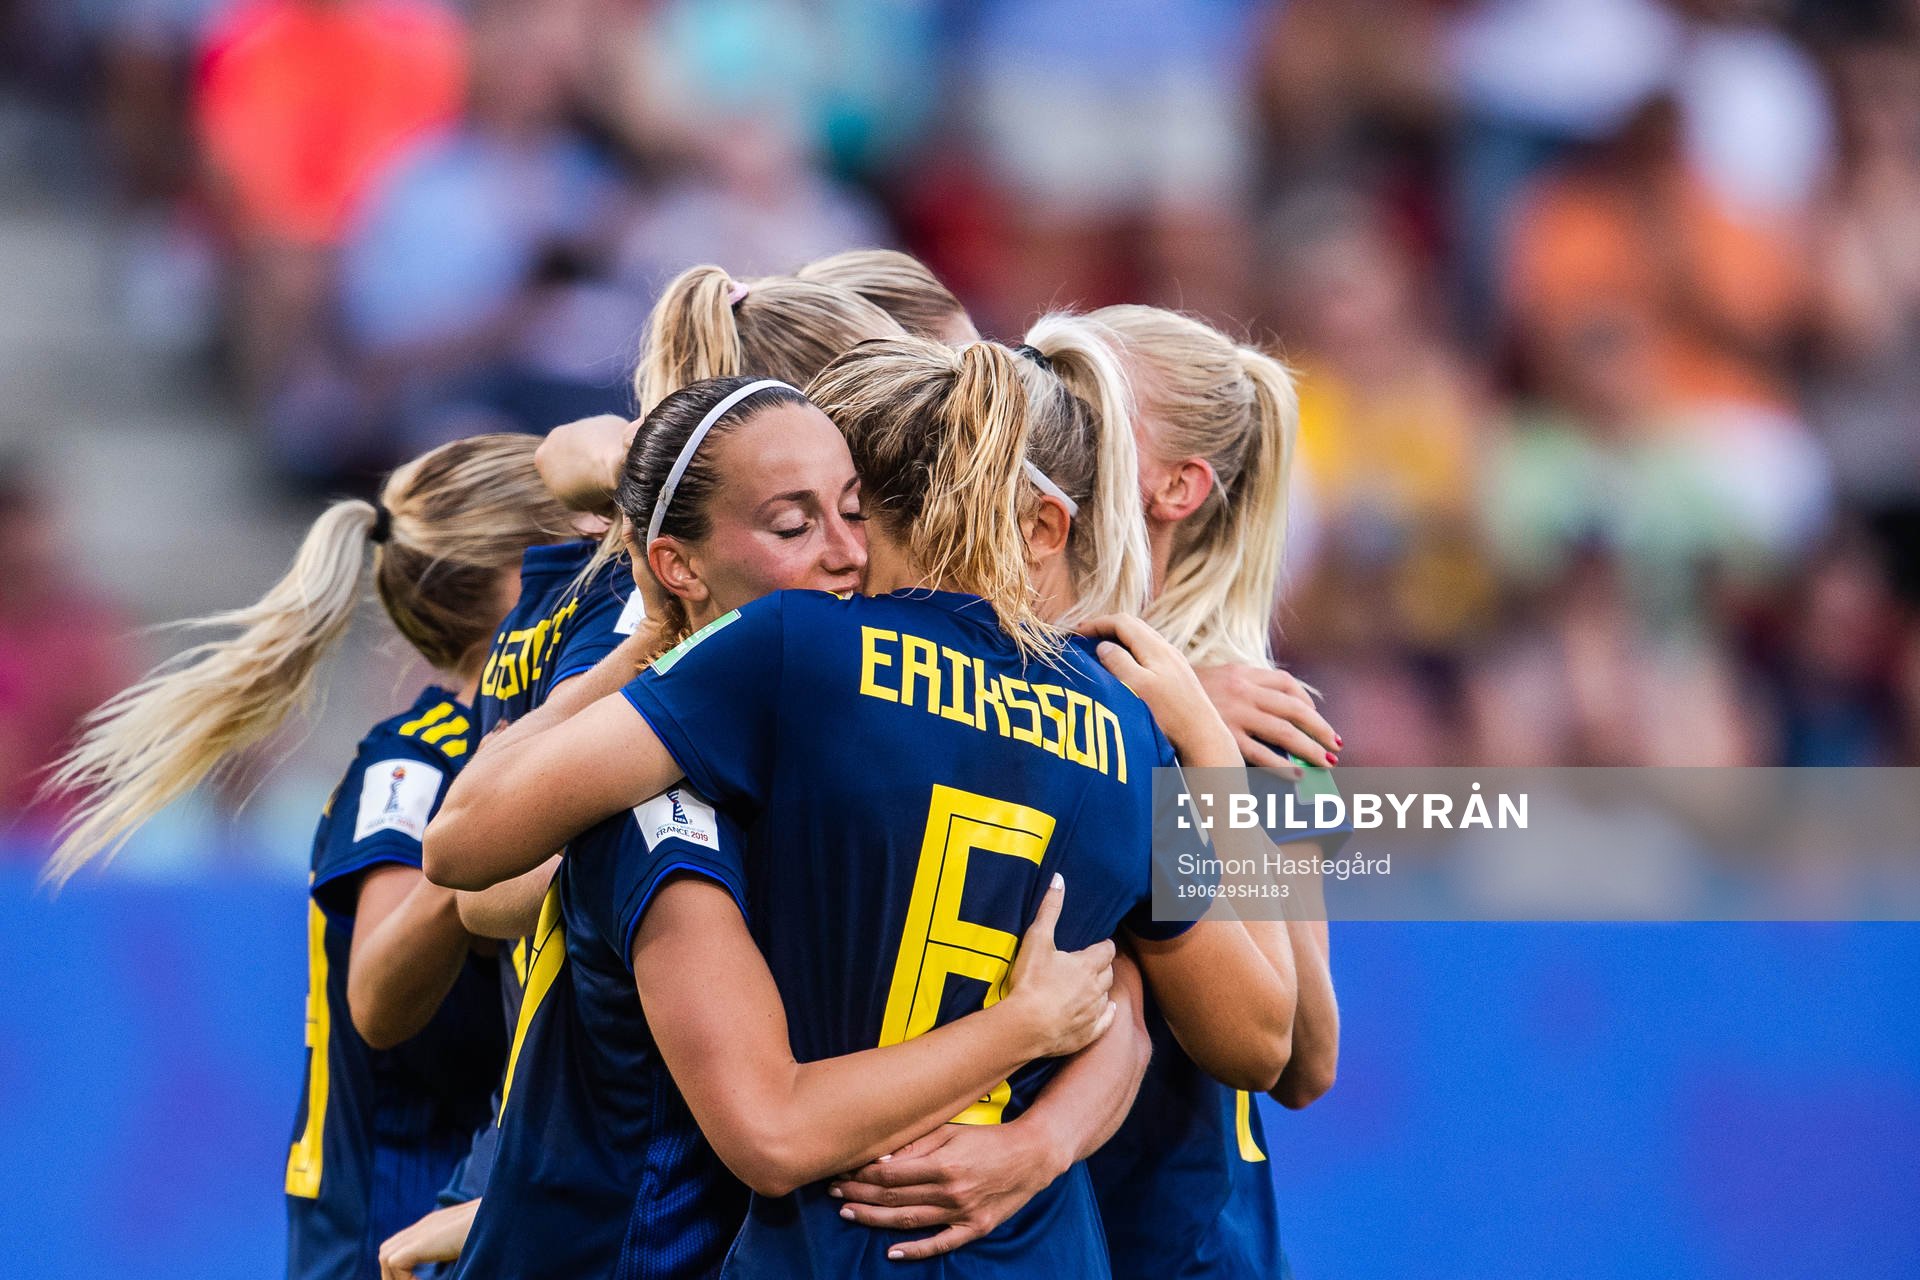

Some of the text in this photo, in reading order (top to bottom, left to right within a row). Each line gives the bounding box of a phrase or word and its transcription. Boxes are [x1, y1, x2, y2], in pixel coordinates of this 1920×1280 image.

[860, 625, 1127, 785] ERIKSSON
[656, 826, 691, 839] FRANCE
[691, 830, 709, 842] 2019
